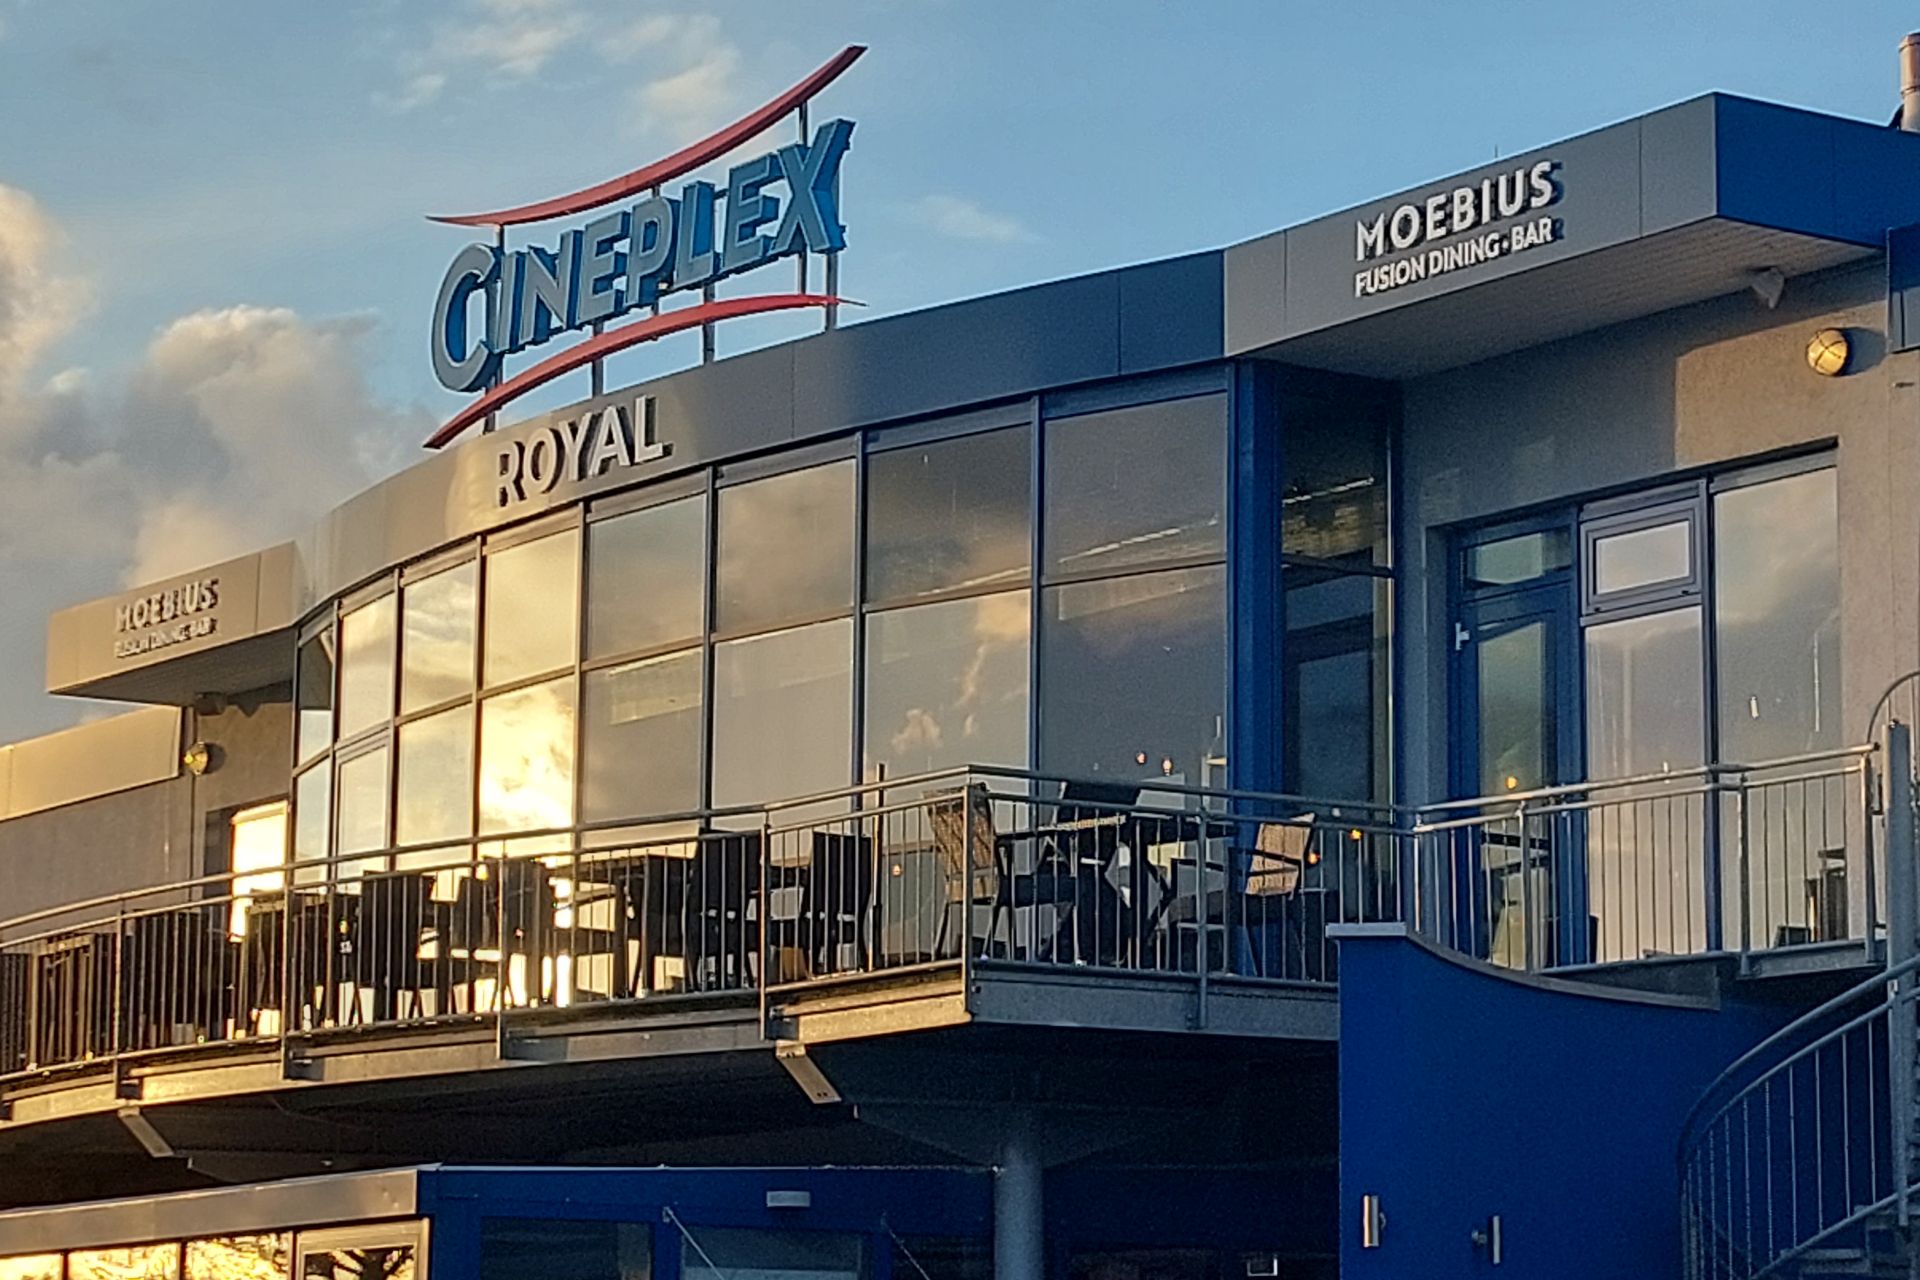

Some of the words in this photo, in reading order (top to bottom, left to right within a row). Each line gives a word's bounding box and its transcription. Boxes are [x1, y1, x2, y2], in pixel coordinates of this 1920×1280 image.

[431, 118, 855, 392] CINEPLEX
[1355, 160, 1559, 262] MOEBIUS
[1354, 254, 1426, 298] FUSION
[494, 395, 671, 509] ROYAL
[115, 578, 218, 633] MOEBIUS
